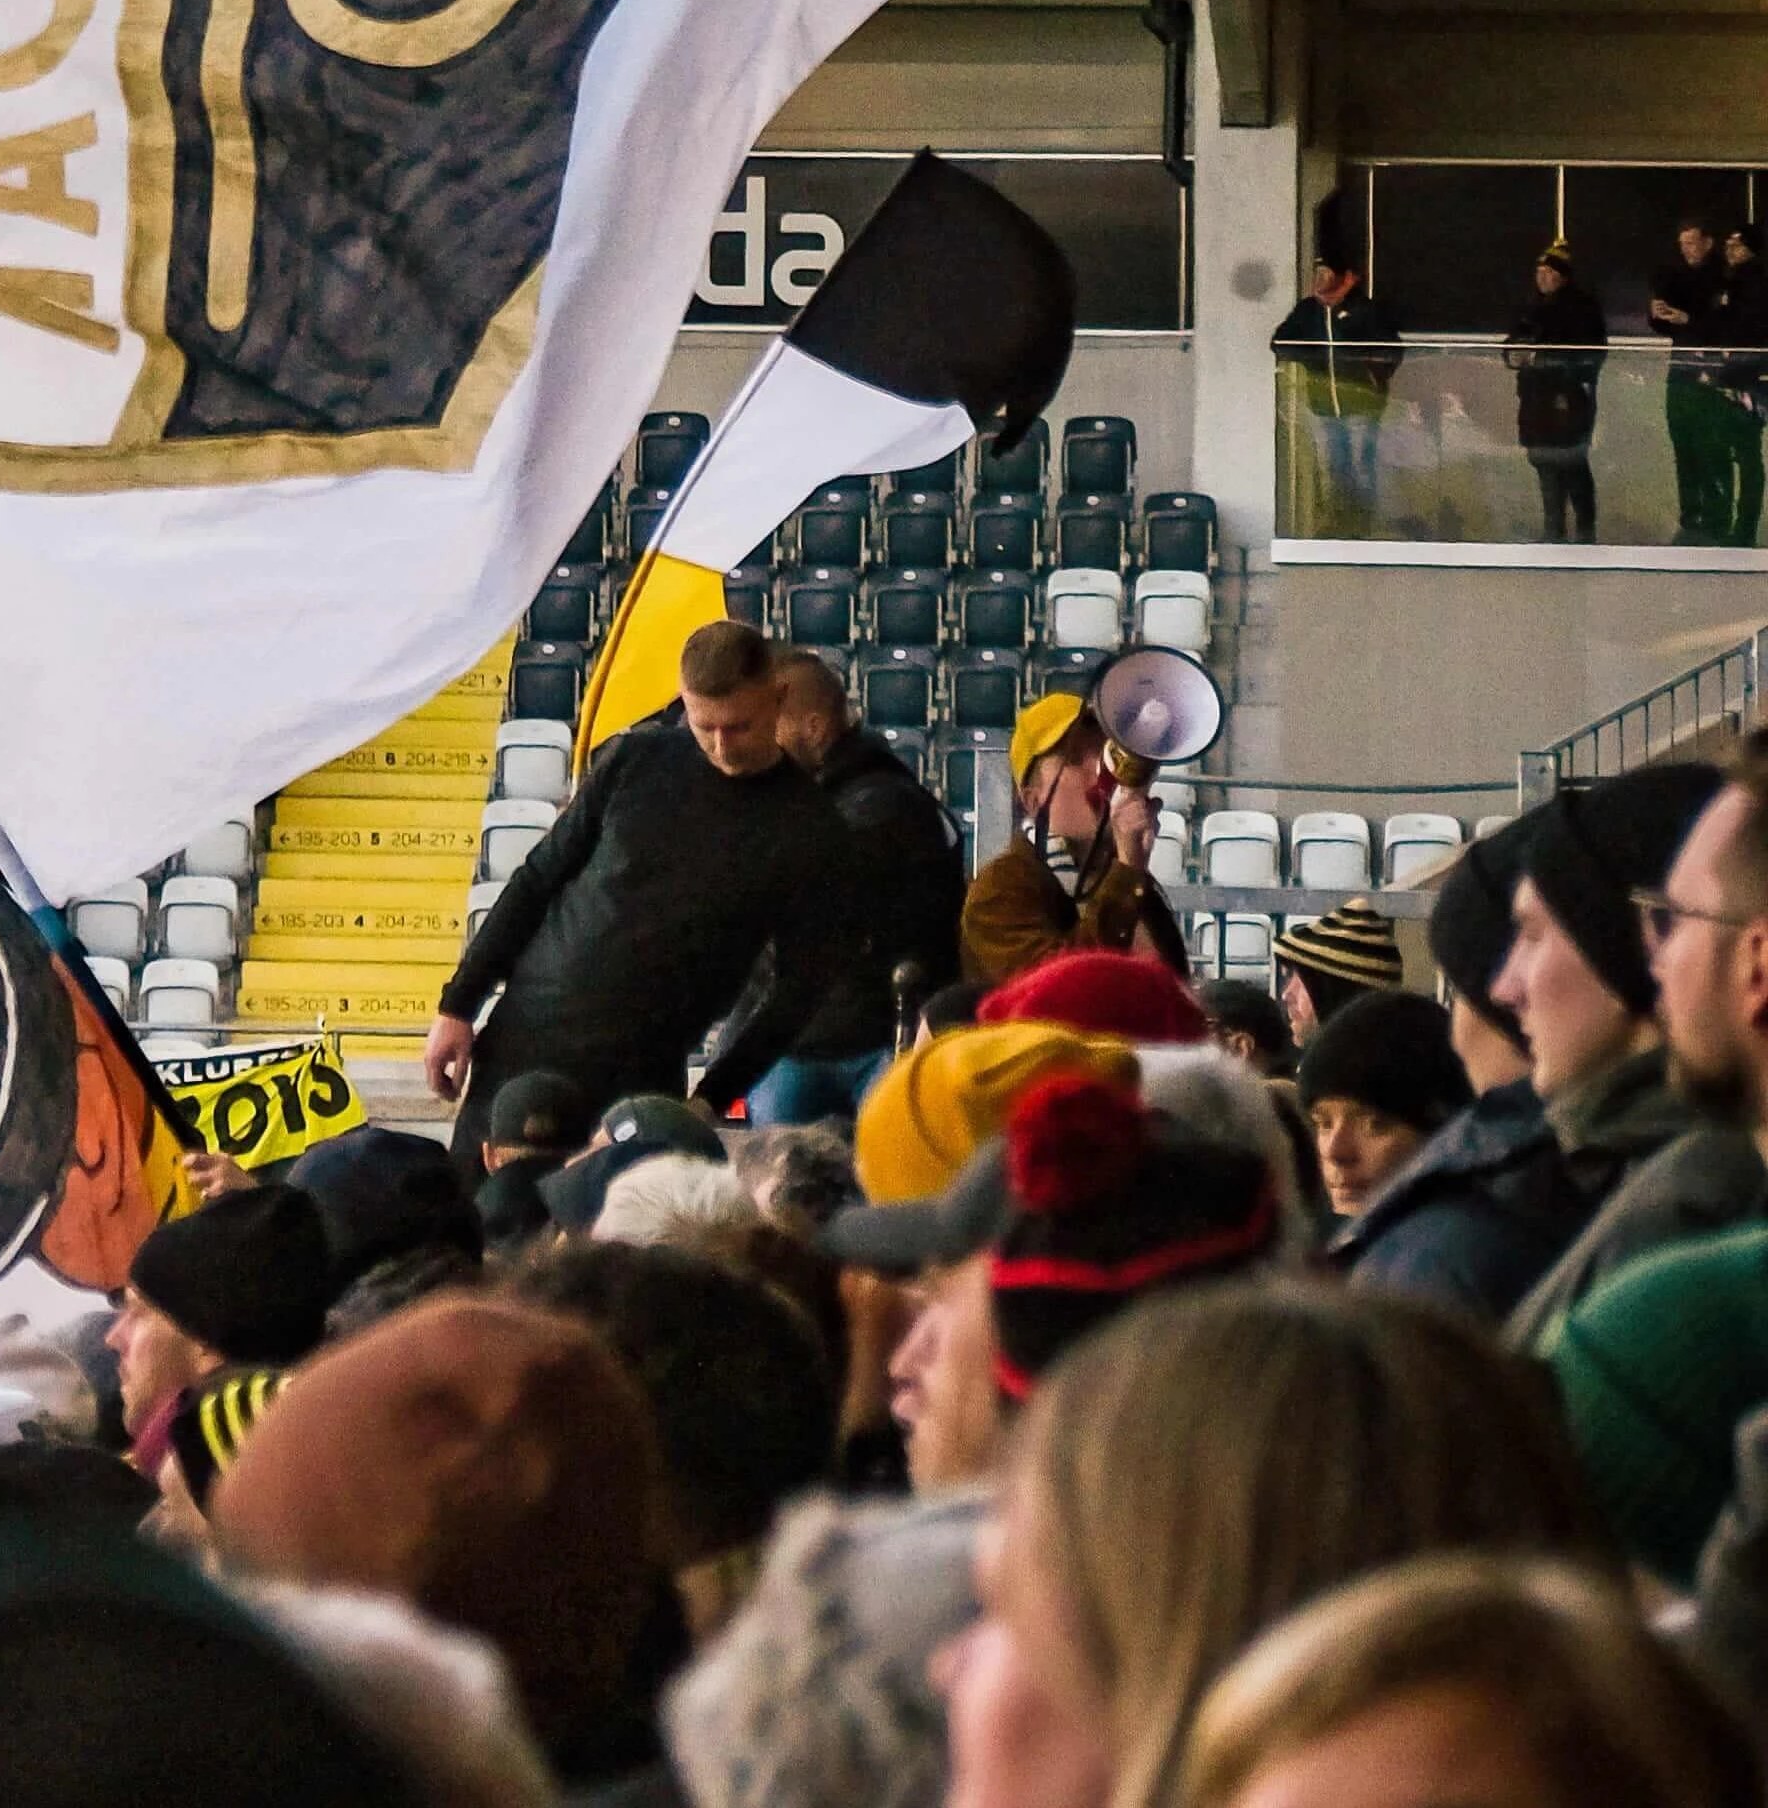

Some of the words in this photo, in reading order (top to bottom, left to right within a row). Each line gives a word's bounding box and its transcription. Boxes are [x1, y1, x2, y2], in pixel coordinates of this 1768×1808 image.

[295, 832, 361, 846] 195-203
[370, 832, 381, 846] 5
[391, 832, 456, 846] 204-217
[279, 913, 345, 928] 195-203
[353, 914, 364, 927] 4
[375, 915, 442, 930] 204-216
[263, 997, 329, 1012] 195-203
[338, 998, 349, 1012] 3
[359, 999, 426, 1014] 204-214
